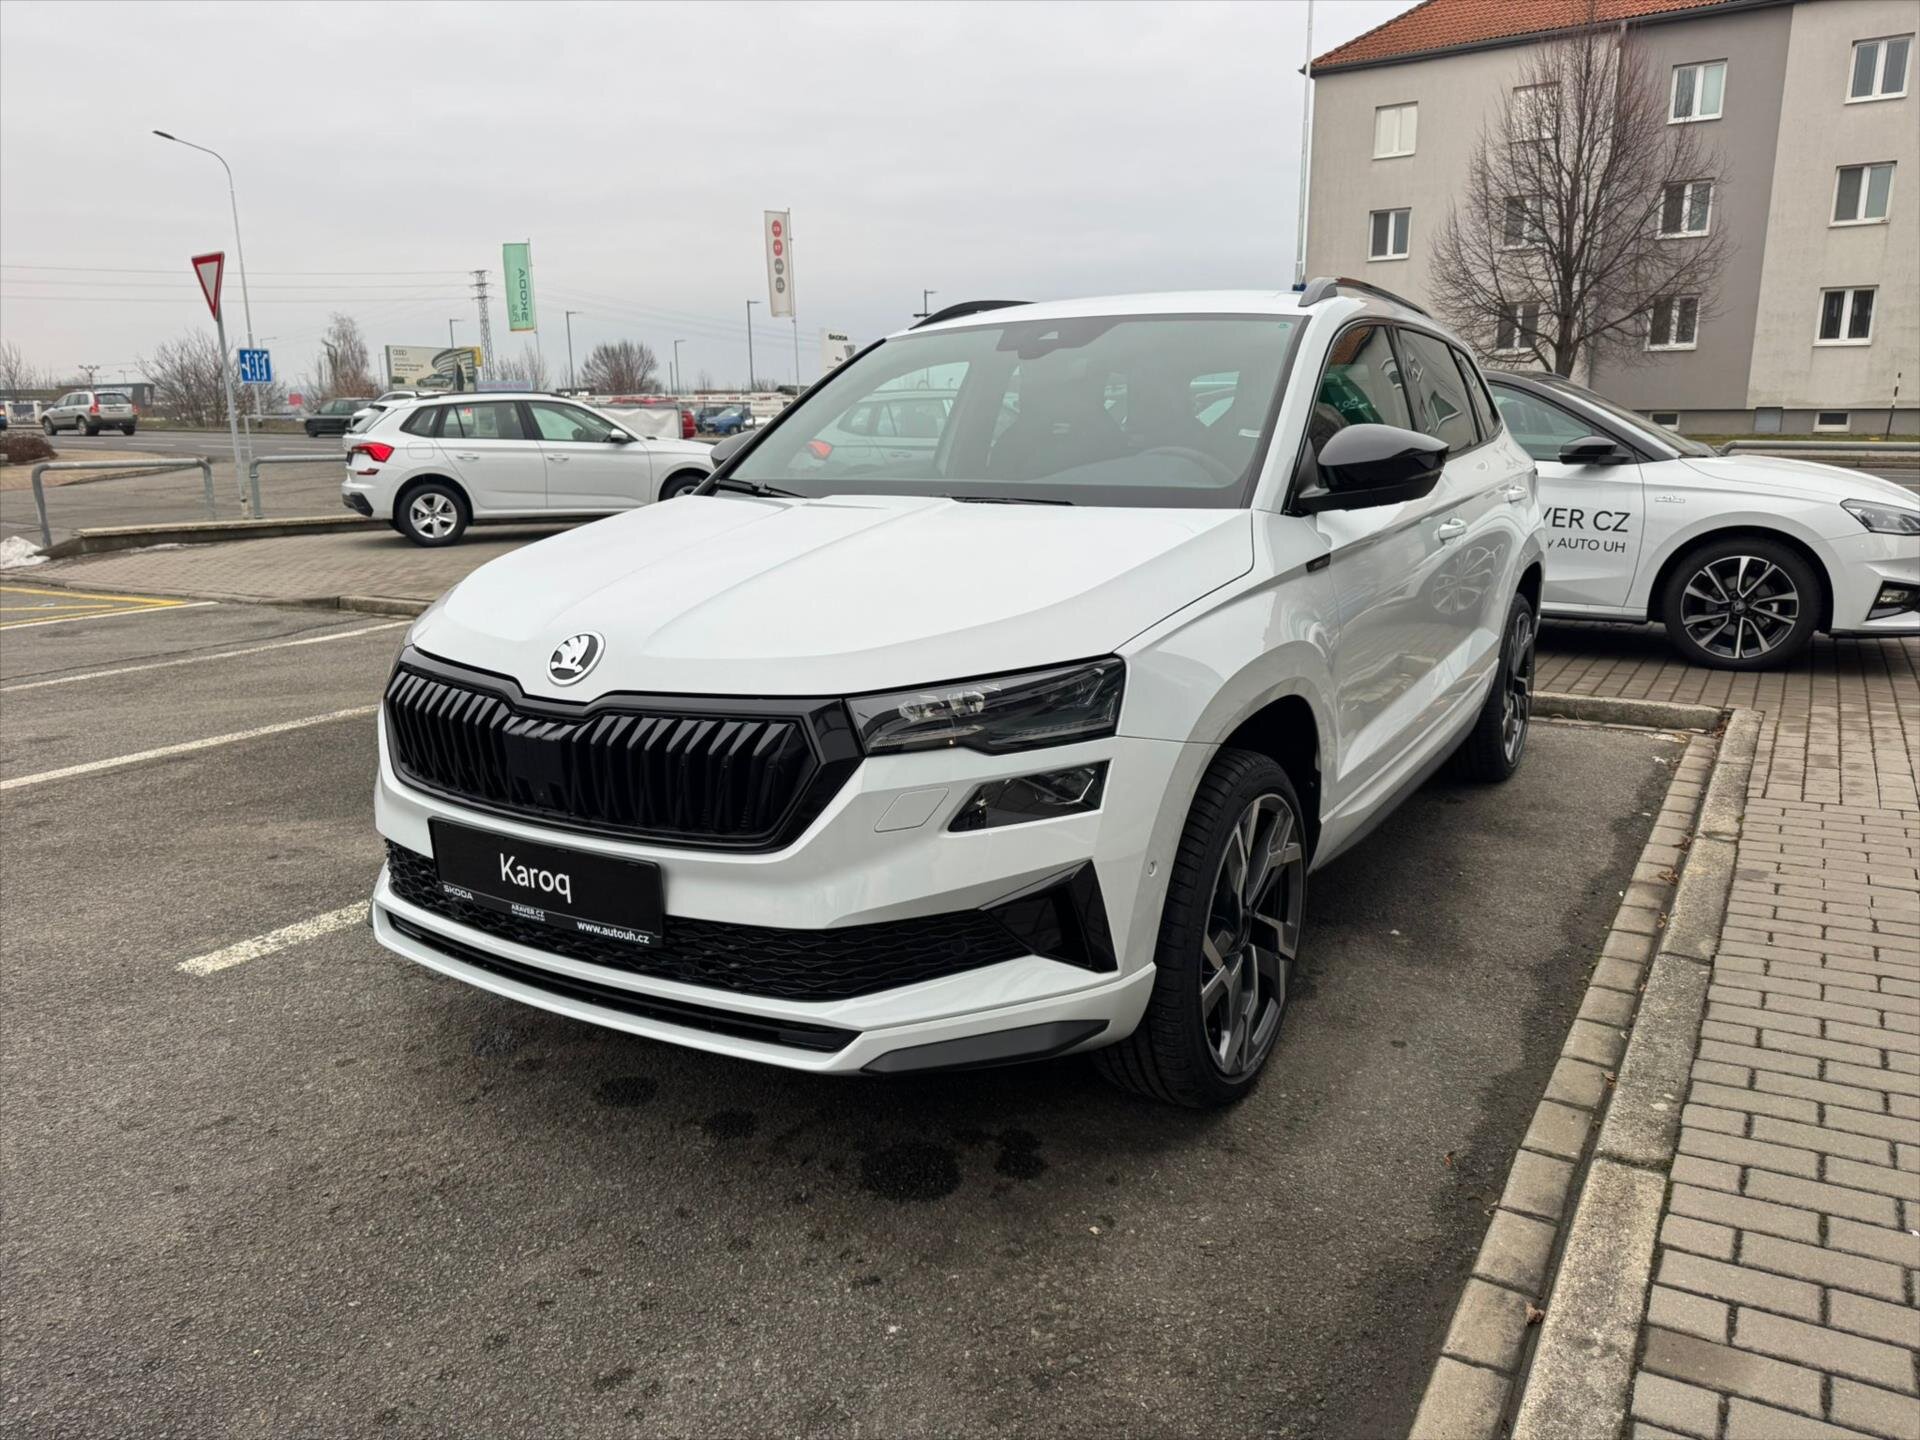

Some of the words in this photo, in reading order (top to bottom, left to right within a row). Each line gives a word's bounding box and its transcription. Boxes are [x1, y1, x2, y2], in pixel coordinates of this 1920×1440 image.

[1593, 510, 1631, 533] CZ
[1557, 537, 1600, 551] AUTO
[1603, 540, 1626, 553] UH
[500, 852, 572, 904] Karoq
[576, 920, 650, 944] www.autouh.cz
